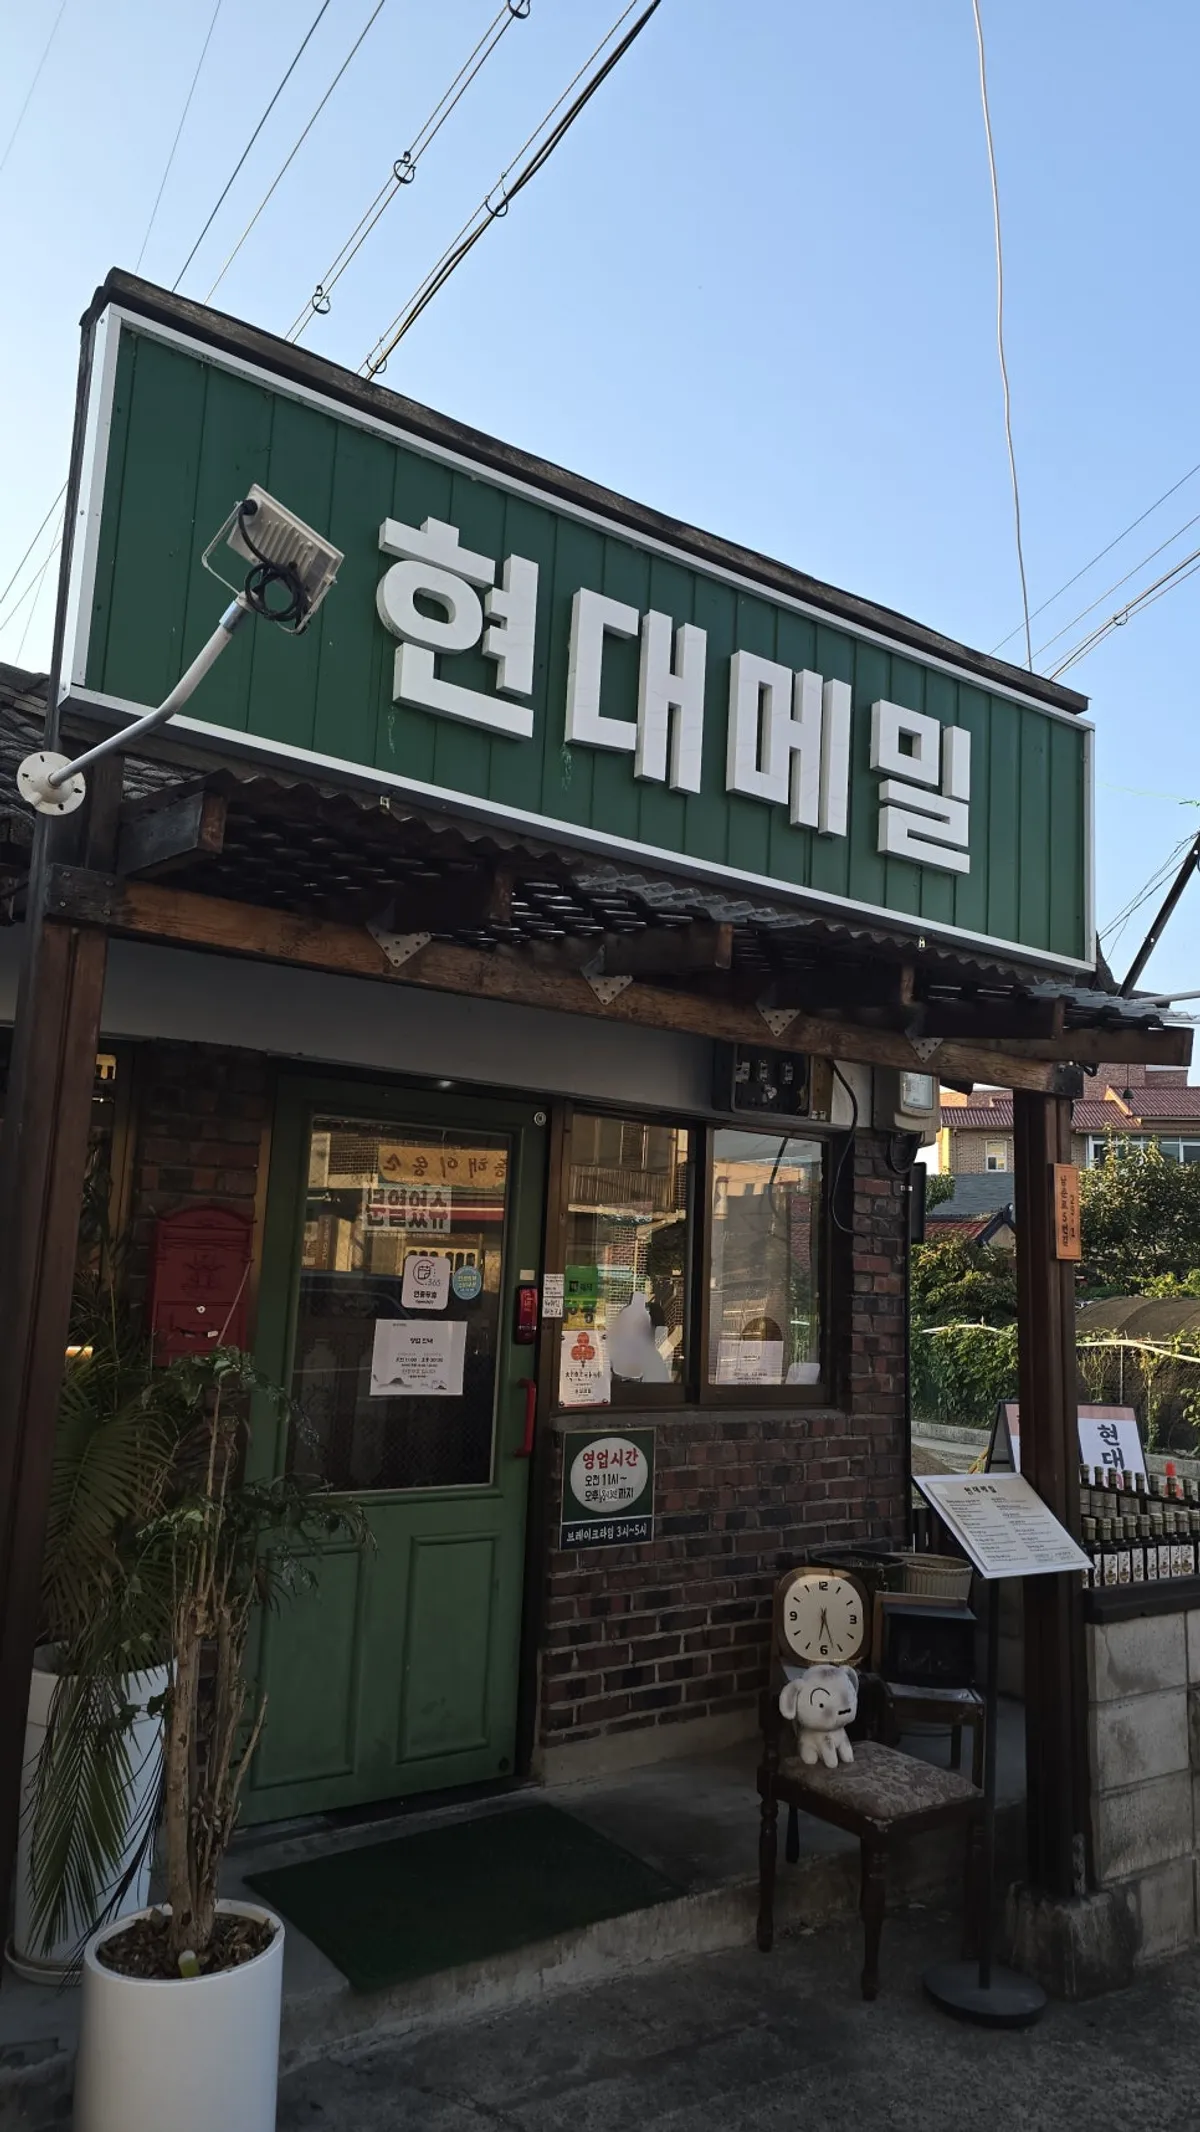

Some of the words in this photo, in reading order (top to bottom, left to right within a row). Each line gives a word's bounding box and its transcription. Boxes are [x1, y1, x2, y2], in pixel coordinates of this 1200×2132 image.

[376, 516, 971, 875] 현대메밀
[413, 1290, 438, 1299] 연중무휴
[582, 1447, 639, 1470] 영업시간
[584, 1474, 600, 1487] 오전
[584, 1490, 599, 1502] 오후
[566, 1526, 615, 1542] 브레이크타임
[616, 1523, 648, 1537] 3시~5시
[818, 1581, 829, 1591] 12
[789, 1611, 798, 1621] 9
[849, 1615, 858, 1625] 3
[819, 1645, 829, 1655] 6
